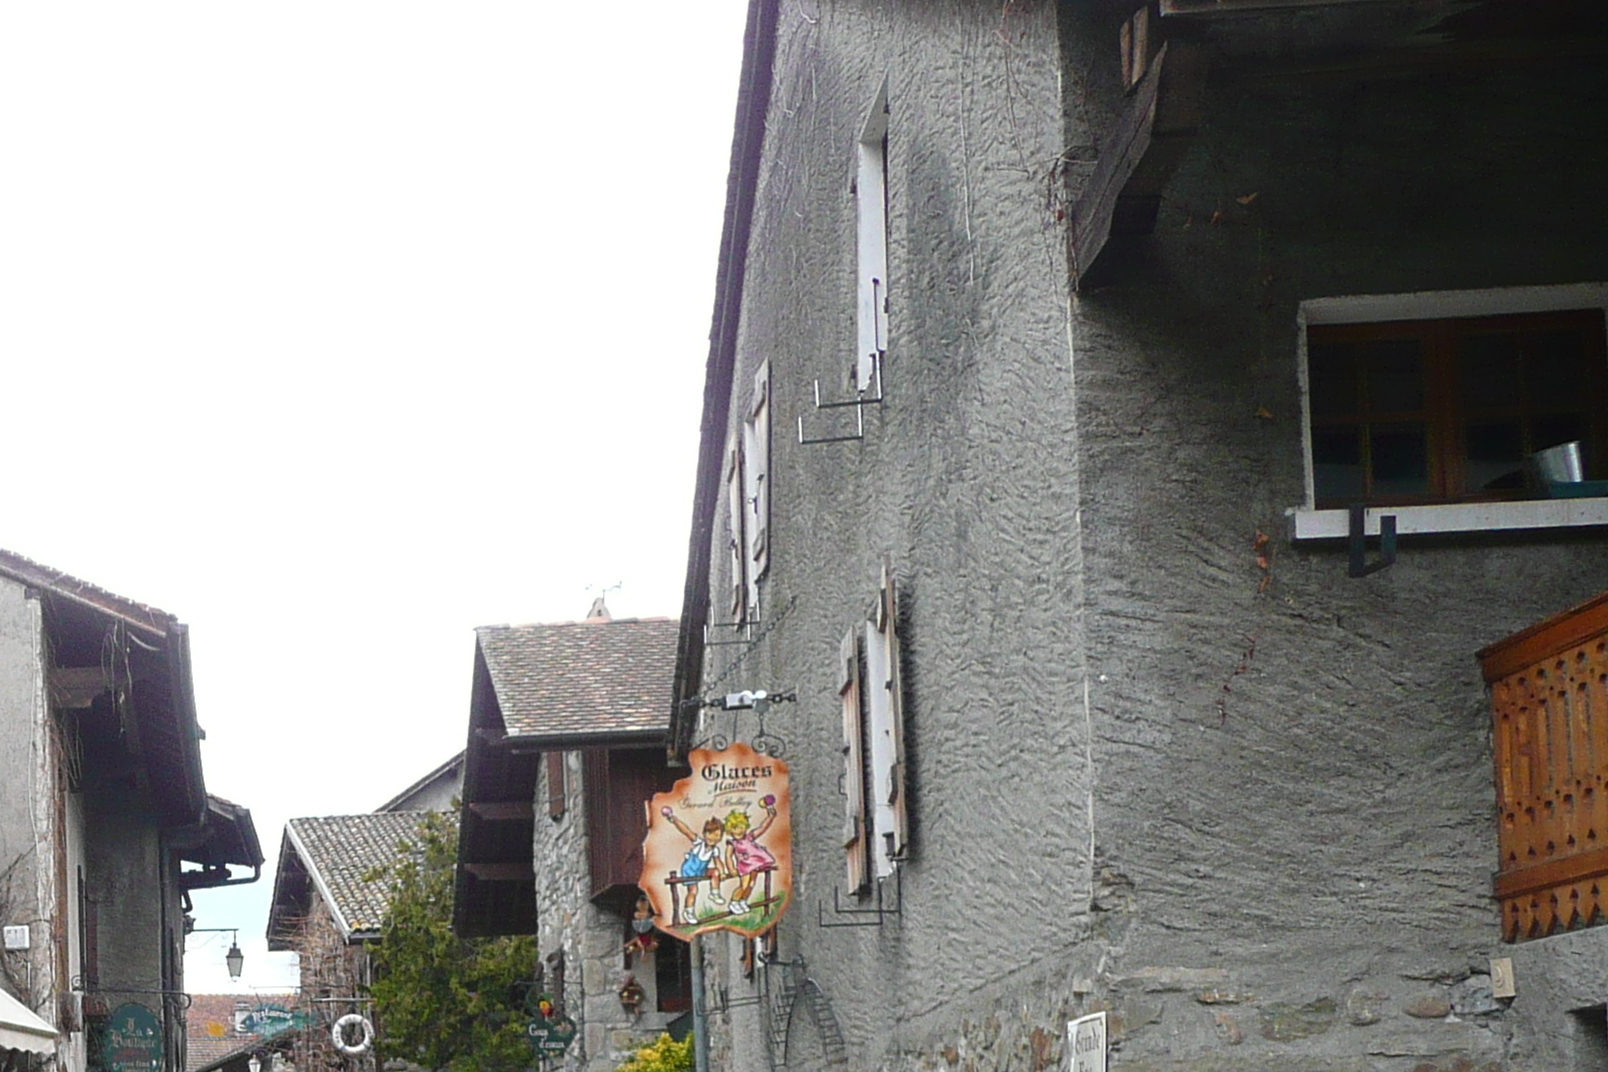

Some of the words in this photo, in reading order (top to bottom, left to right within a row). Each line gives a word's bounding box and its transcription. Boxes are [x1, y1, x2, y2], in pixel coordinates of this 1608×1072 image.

[701, 763, 772, 781] Glaces
[707, 779, 757, 795] Maison
[1075, 1025, 1101, 1055] Grande
